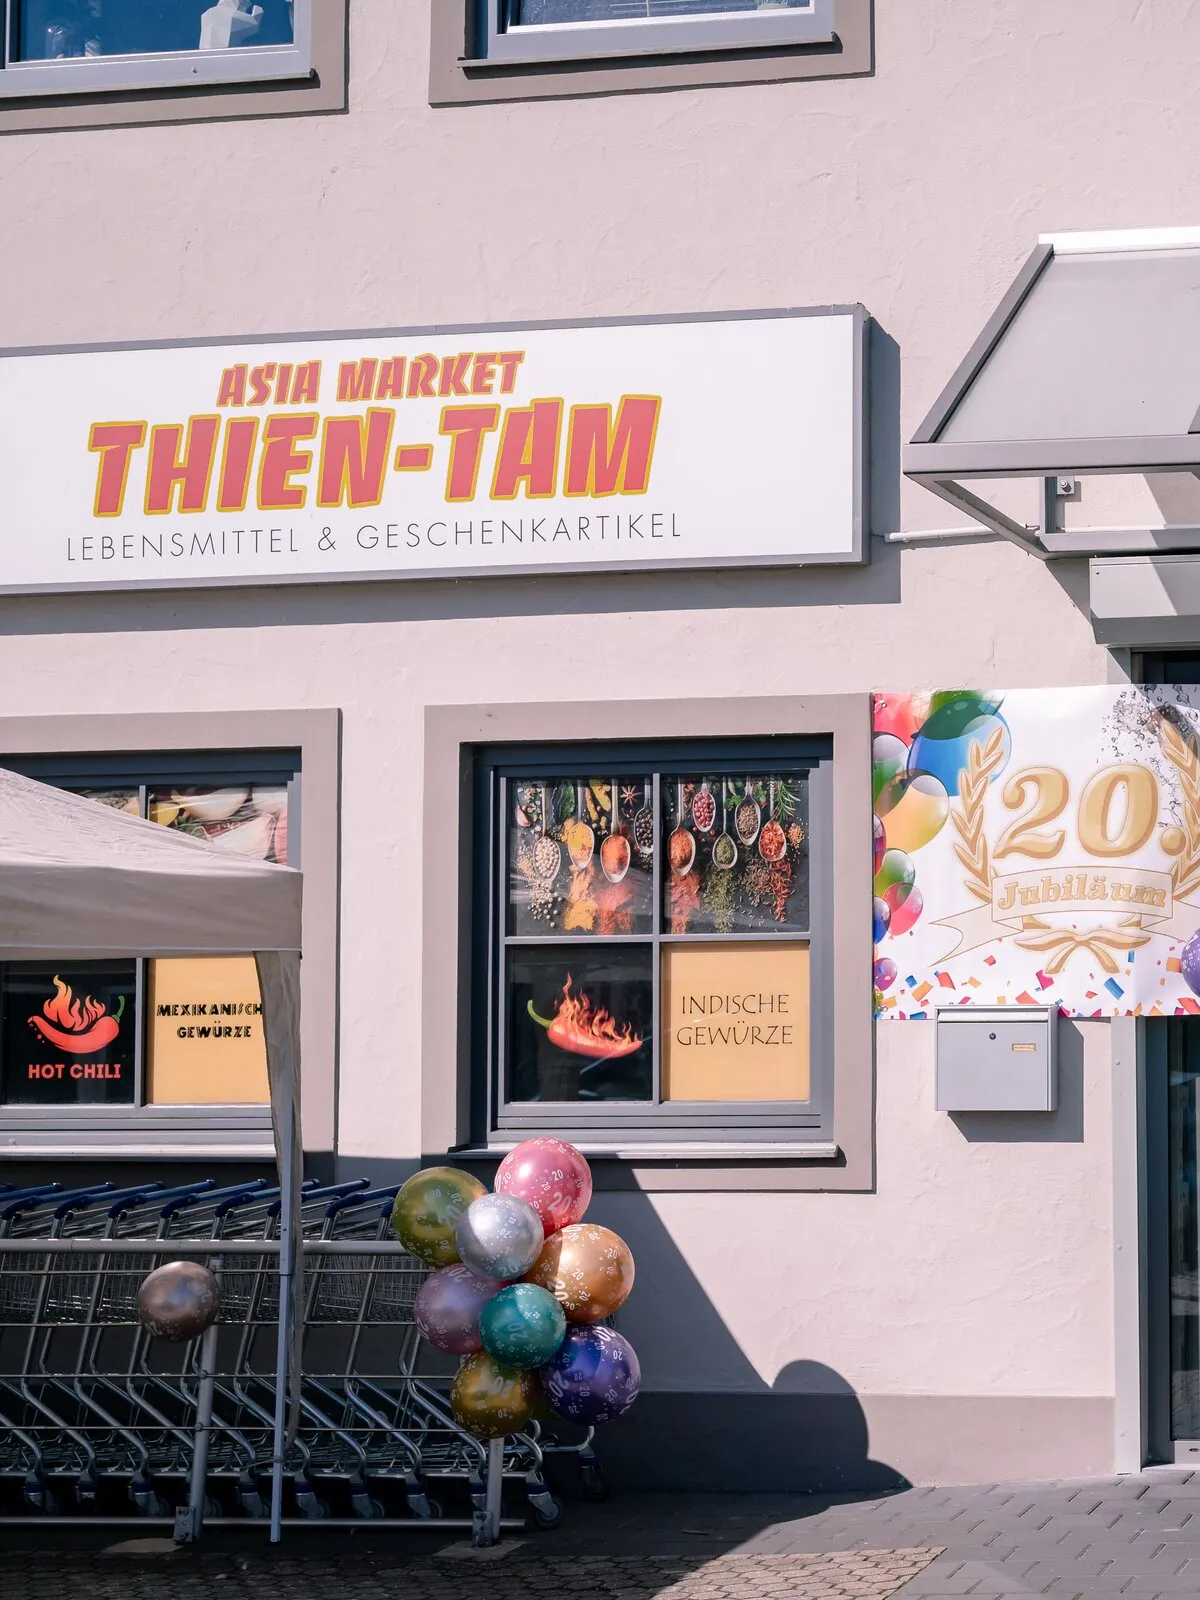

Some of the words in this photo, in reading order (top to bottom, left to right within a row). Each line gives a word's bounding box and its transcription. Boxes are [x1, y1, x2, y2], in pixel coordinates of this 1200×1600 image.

[217, 360, 322, 407] ASIA
[337, 350, 525, 404] MARKET
[88, 394, 662, 517] THIEN-TAM
[66, 528, 299, 561] LEBENSMITTEL
[317, 526, 337, 552] &
[357, 513, 682, 550] GESCHENKARTIKEL
[992, 763, 1187, 859] 20.
[998, 873, 1166, 910] Jubiläum
[157, 1003, 263, 1017] MEXIKANISCH
[682, 993, 789, 1014] INDISCHE
[177, 1021, 252, 1038] GEWÜRZE
[676, 1020, 793, 1046] GEWÜRZE
[28, 1064, 65, 1079] HOT
[70, 1064, 121, 1079] CHILI
[503, 1172, 511, 1184] 20
[552, 1169, 563, 1181] 20
[542, 1182, 551, 1191] 20
[548, 1192, 572, 1213] 20
[608, 1248, 617, 1258] 20
[572, 1269, 584, 1280] 20
[580, 1291, 591, 1301] 20
[613, 1349, 622, 1360] 20
[498, 1409, 507, 1417] 20
